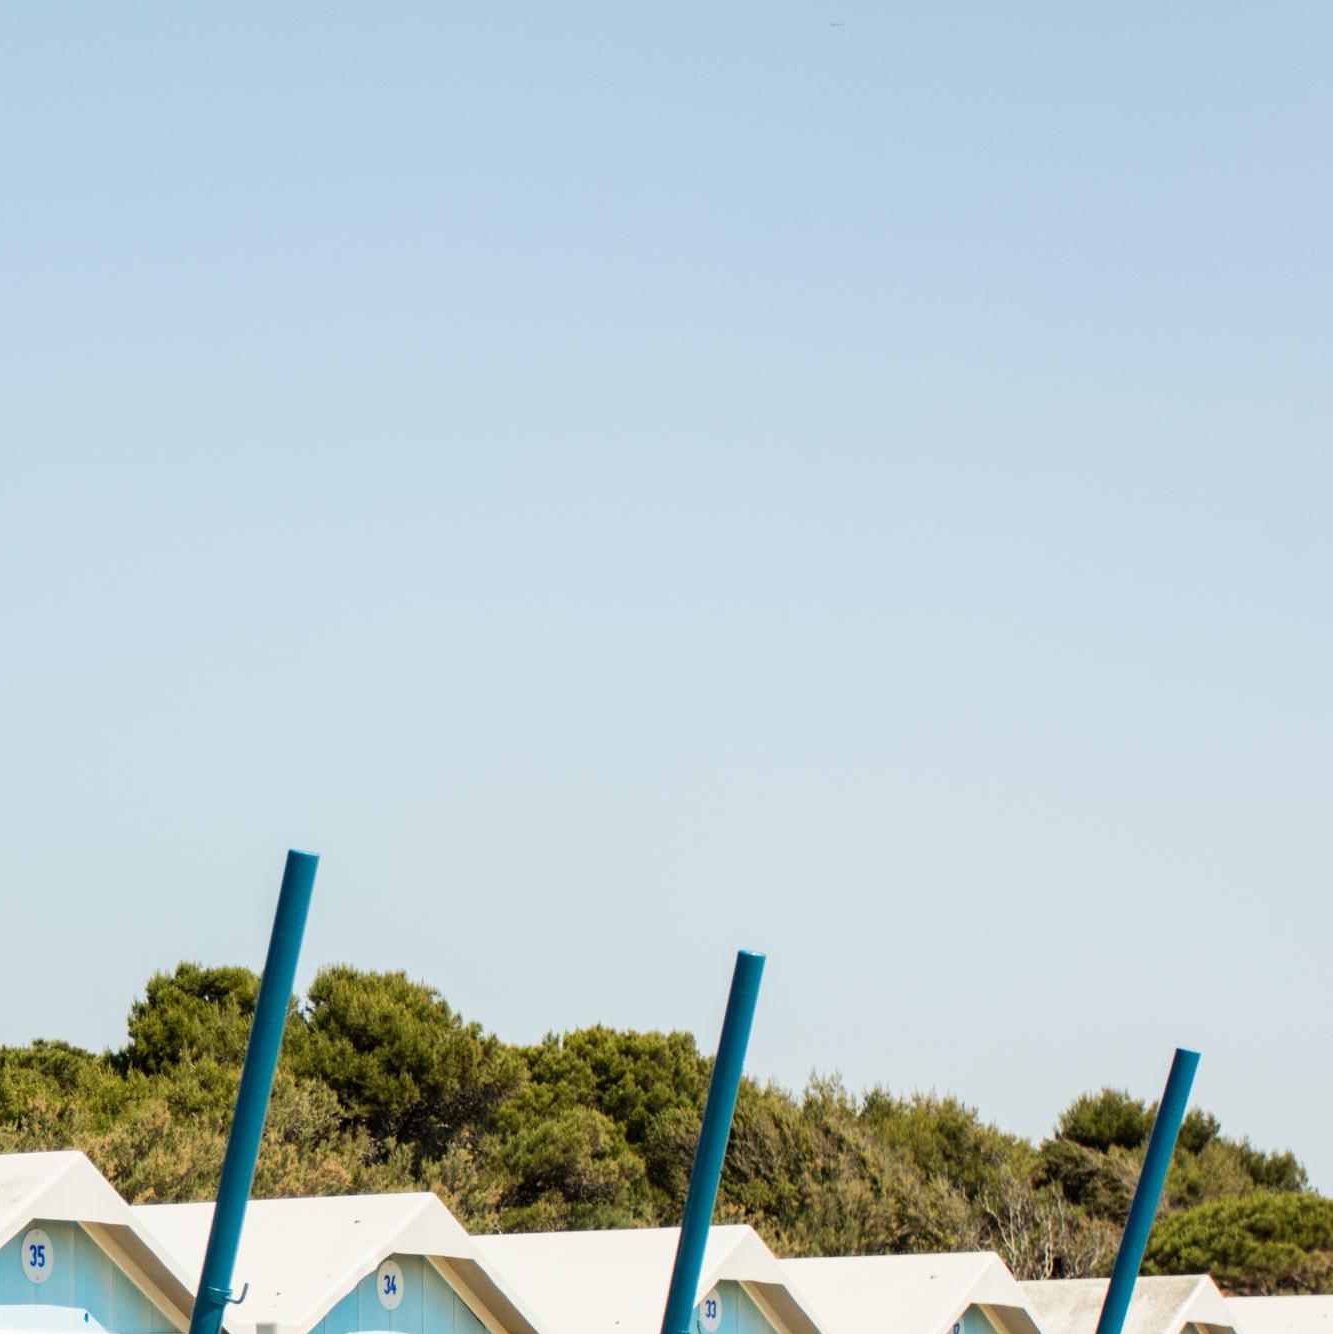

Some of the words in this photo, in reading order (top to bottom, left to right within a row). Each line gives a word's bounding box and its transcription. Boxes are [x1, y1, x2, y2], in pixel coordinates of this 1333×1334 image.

[29, 1244, 46, 1268] 35
[383, 1274, 397, 1295] 34
[705, 1300, 717, 1319] 33
